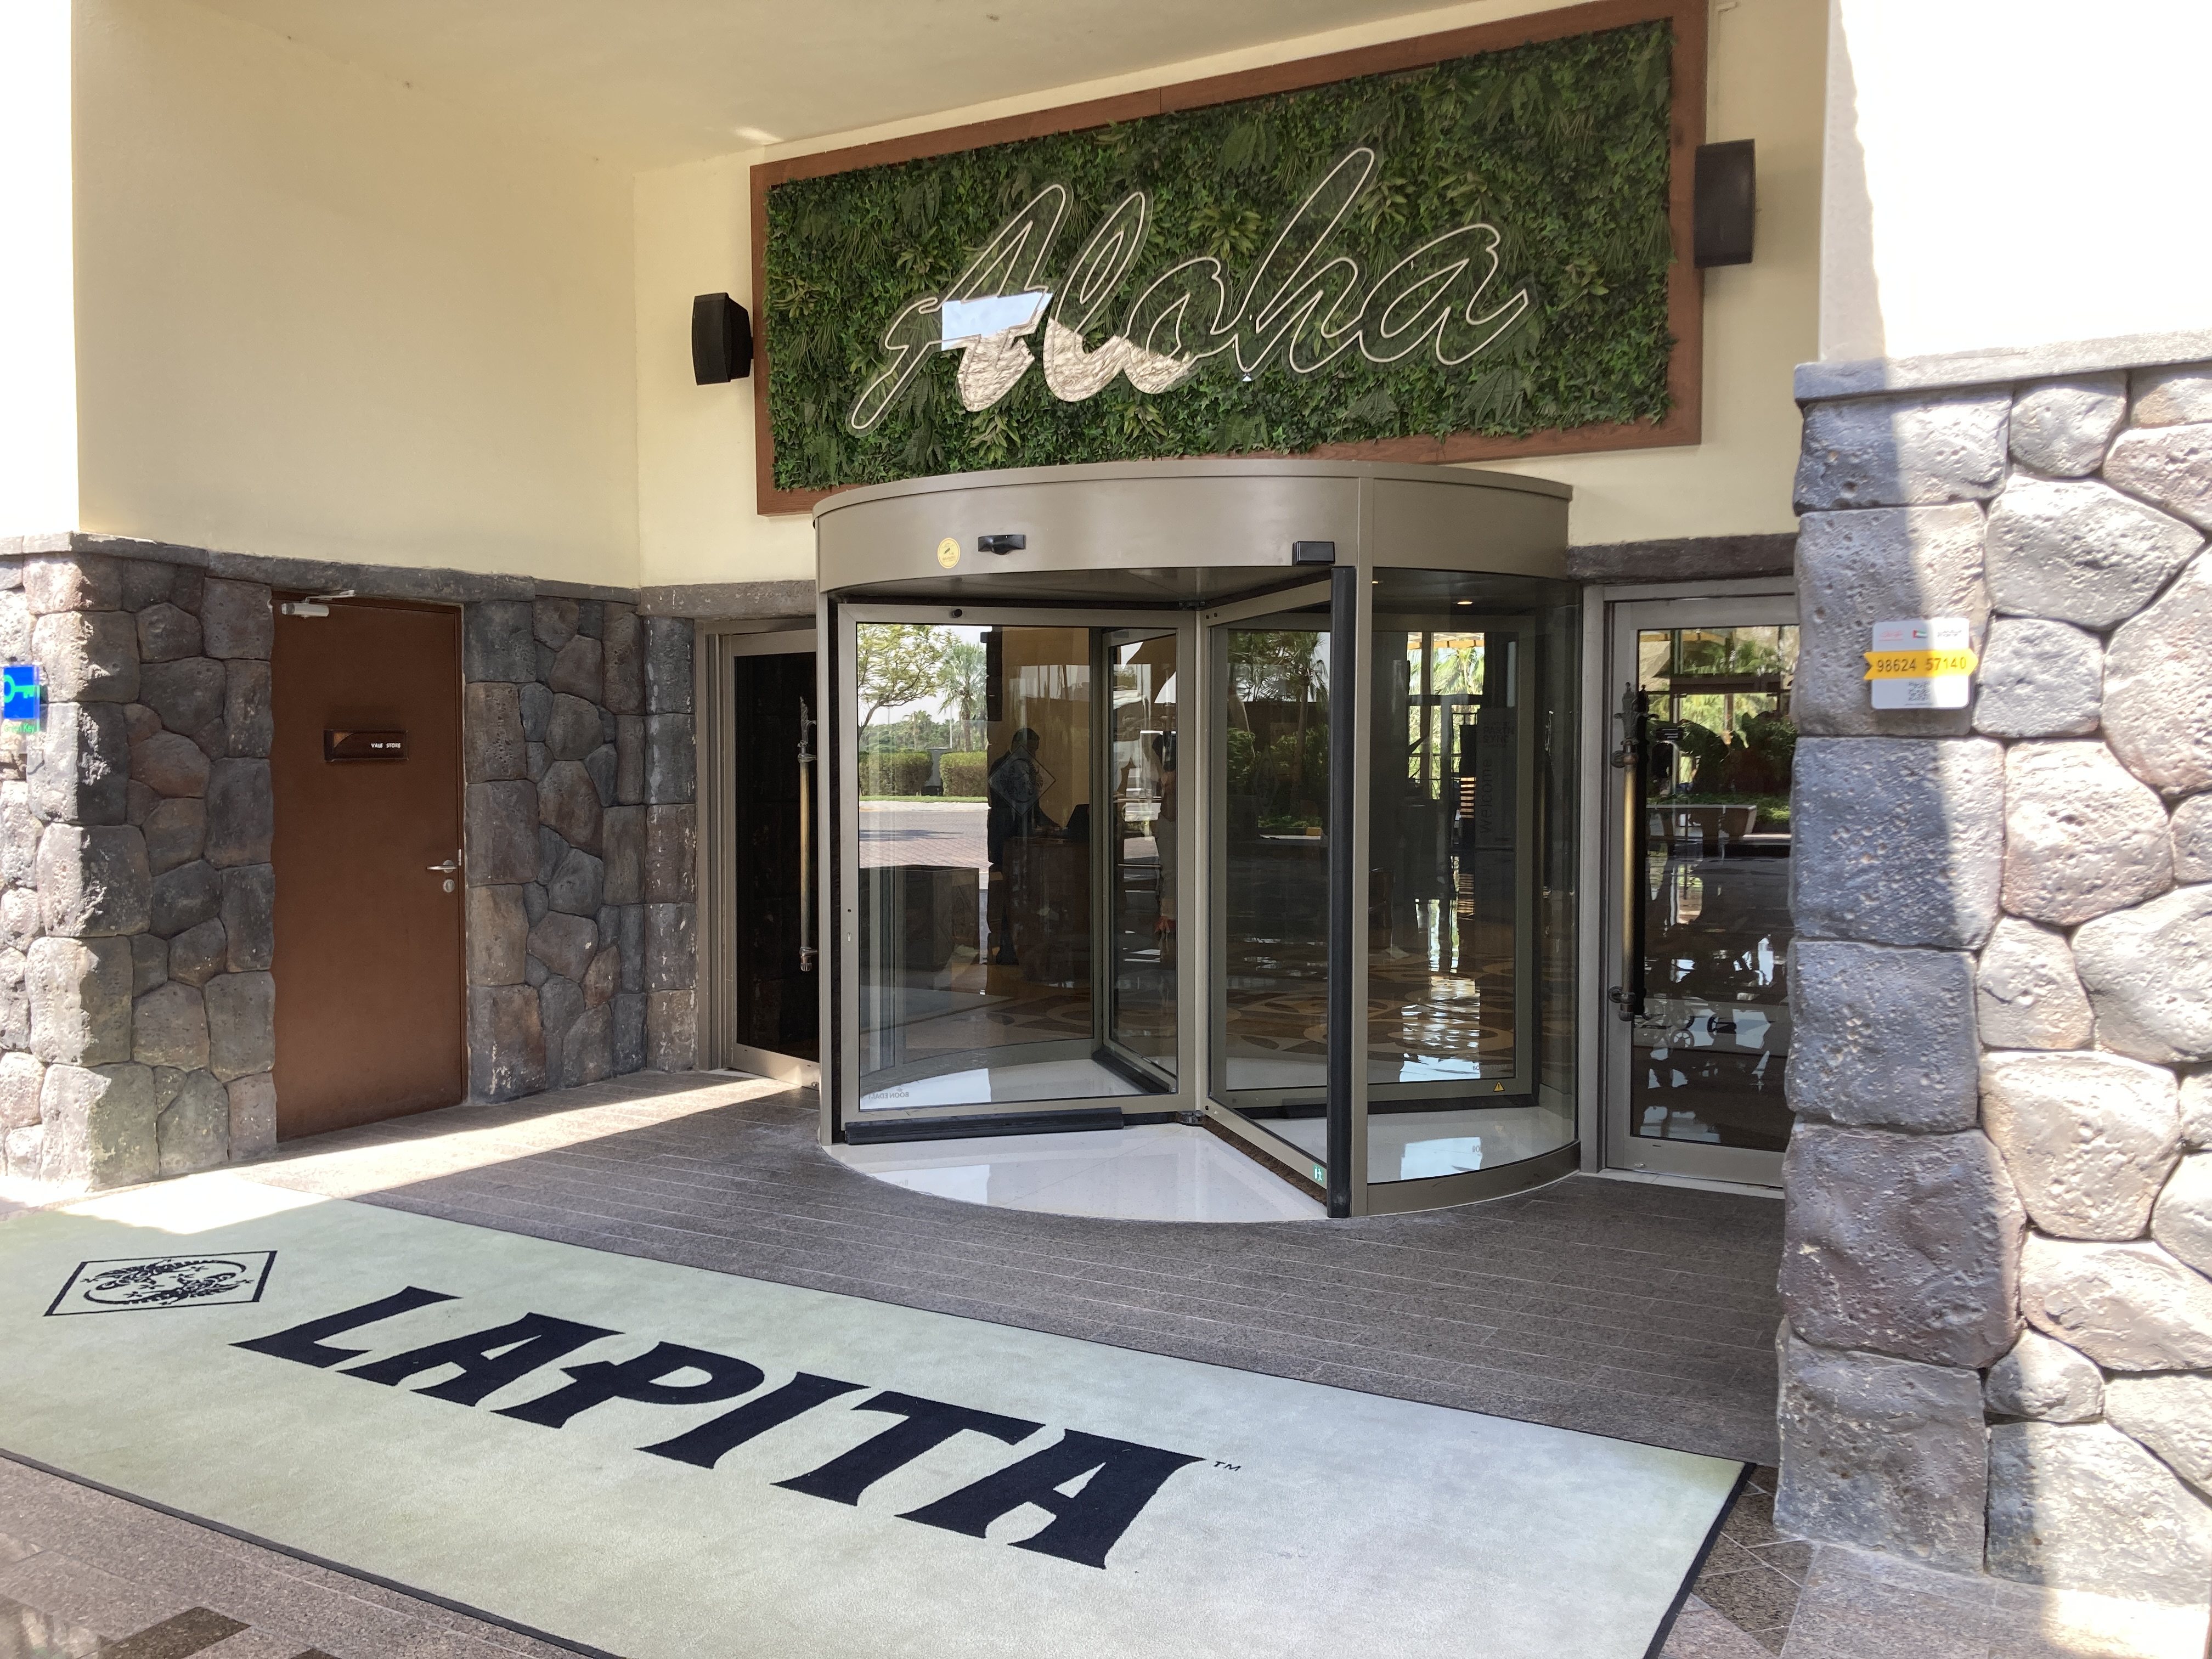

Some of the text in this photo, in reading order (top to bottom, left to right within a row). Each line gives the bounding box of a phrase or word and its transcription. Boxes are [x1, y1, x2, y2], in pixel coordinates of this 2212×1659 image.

[850, 147, 1529, 430] Aloha
[23, 723, 35, 734] Key
[1877, 657, 1967, 672] 98624 57140
[229, 1286, 1207, 1570] LAPITA
